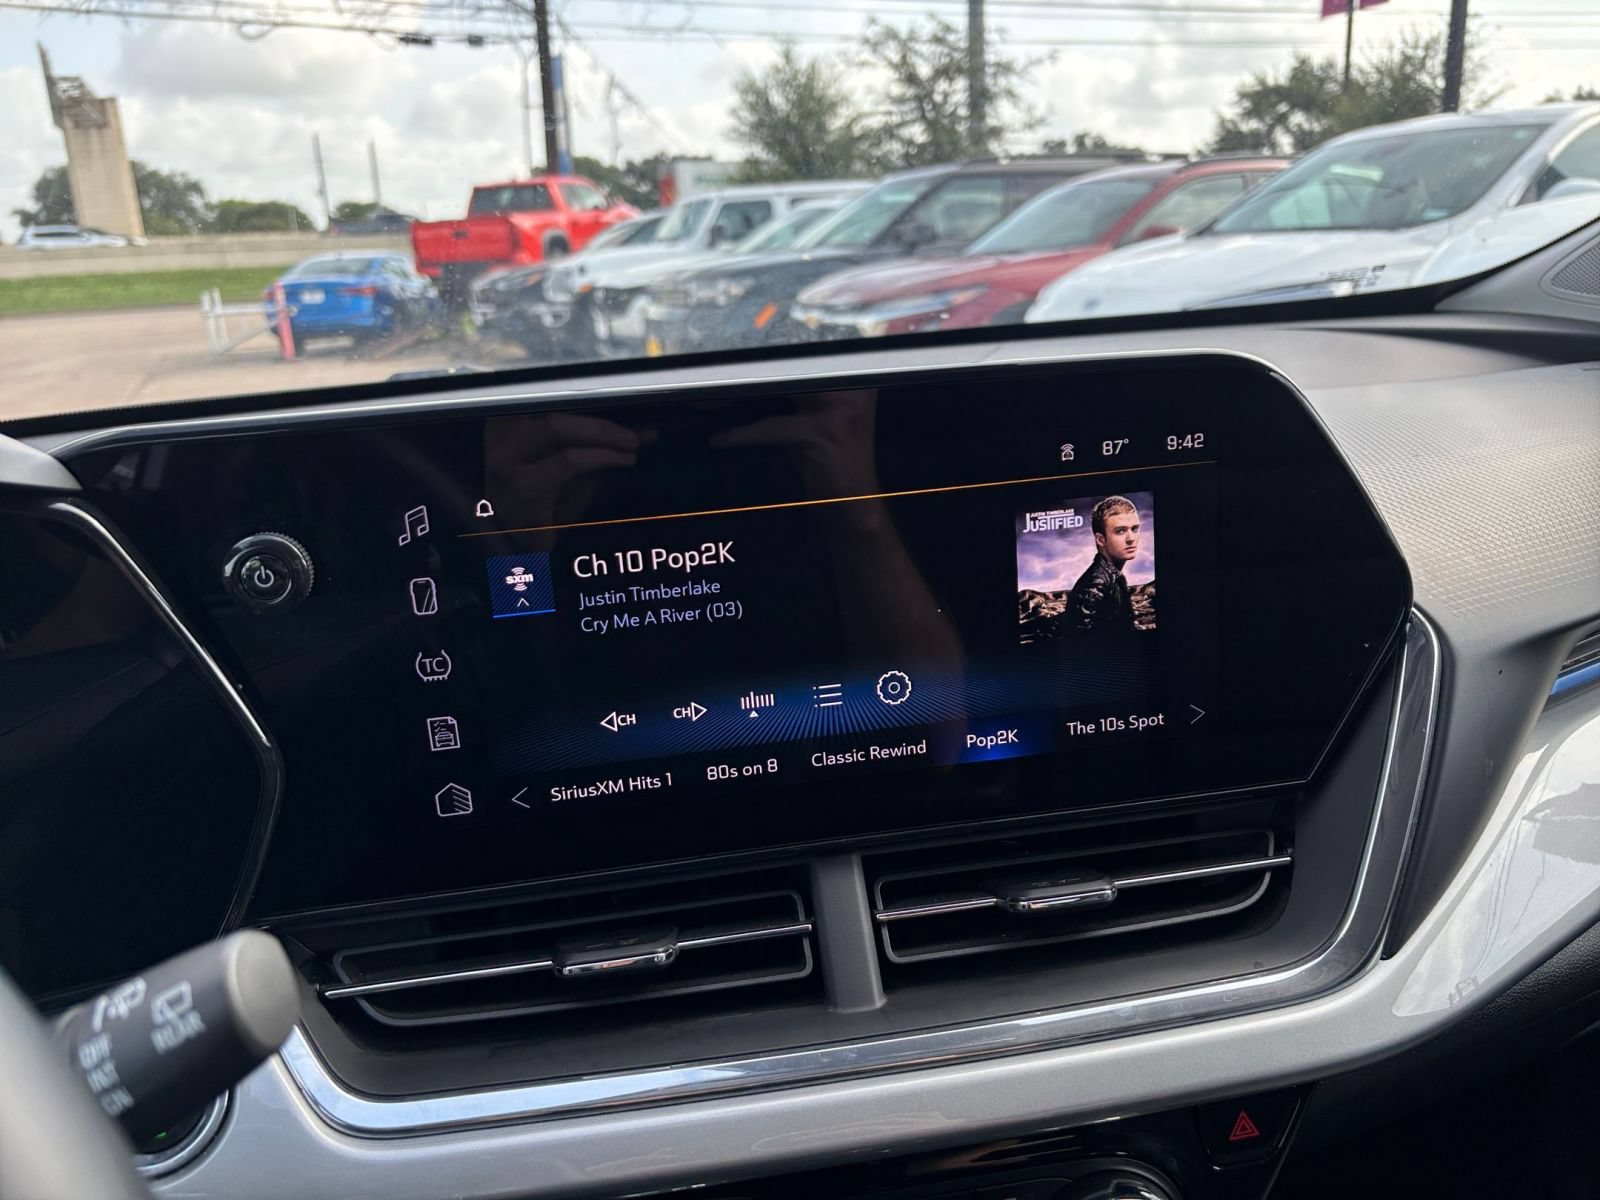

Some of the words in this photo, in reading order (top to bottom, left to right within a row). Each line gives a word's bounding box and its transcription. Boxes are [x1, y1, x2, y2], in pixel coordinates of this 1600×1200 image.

[1102, 438, 1129, 456] 87°
[1167, 432, 1204, 450] 9:42
[573, 553, 608, 578] Ch
[614, 550, 644, 574] 10
[651, 541, 736, 573] Pop2K
[505, 573, 534, 585] sxm
[579, 590, 626, 609] Justin
[629, 580, 721, 603] Timberlake
[581, 617, 609, 635] Cry
[613, 613, 640, 629] Me
[644, 610, 657, 625] A
[660, 608, 701, 624] River
[706, 600, 743, 622] (03)
[421, 657, 445, 674] TC
[618, 713, 637, 726] CH
[673, 706, 691, 719] CH
[1066, 720, 1096, 736] The
[1099, 717, 1126, 732] 10s
[1129, 713, 1165, 731] Spot
[966, 728, 1019, 751] Pop2K
[811, 748, 866, 767] Classic
[869, 739, 927, 760] Rewind
[706, 764, 739, 781] 80s
[742, 764, 763, 776] on
[767, 758, 778, 773] 8
[550, 778, 625, 802] SiriusXM
[628, 776, 662, 791] Hits
[665, 772, 672, 786] 1
